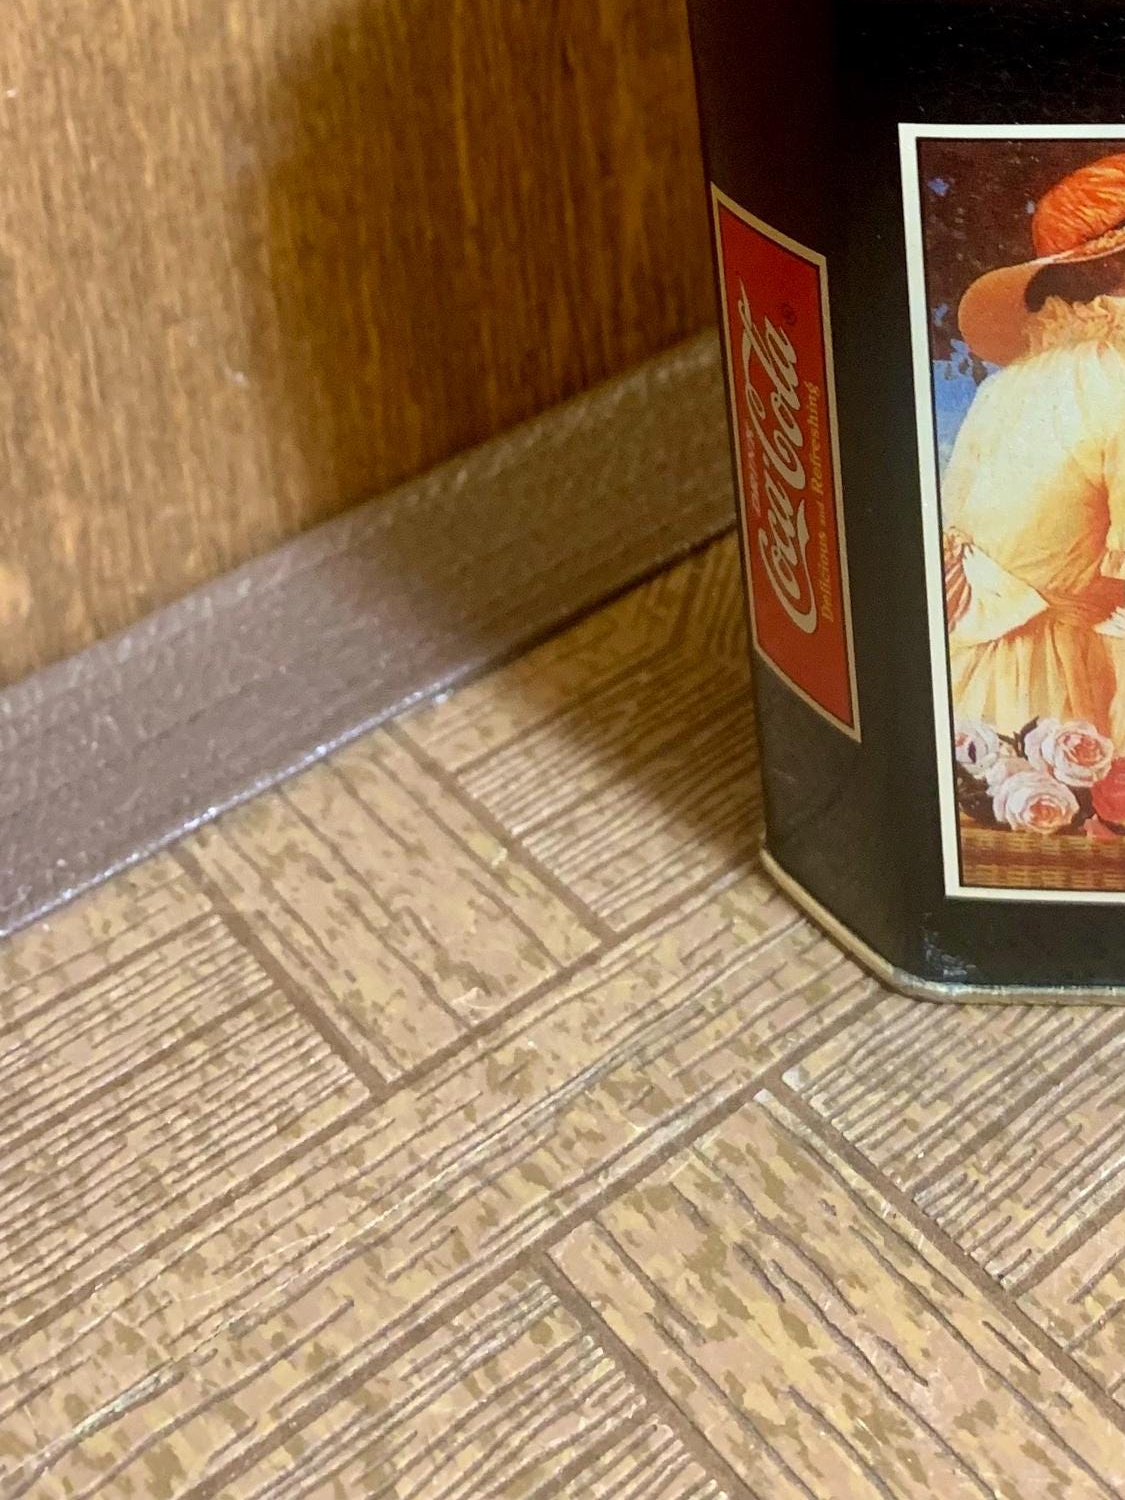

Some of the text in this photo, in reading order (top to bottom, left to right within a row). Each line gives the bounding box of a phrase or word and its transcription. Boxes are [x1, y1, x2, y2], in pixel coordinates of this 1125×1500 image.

[736, 276, 818, 635] Coca-Cola
[803, 379, 826, 496] Refreshing
[816, 531, 835, 623] Delicious
